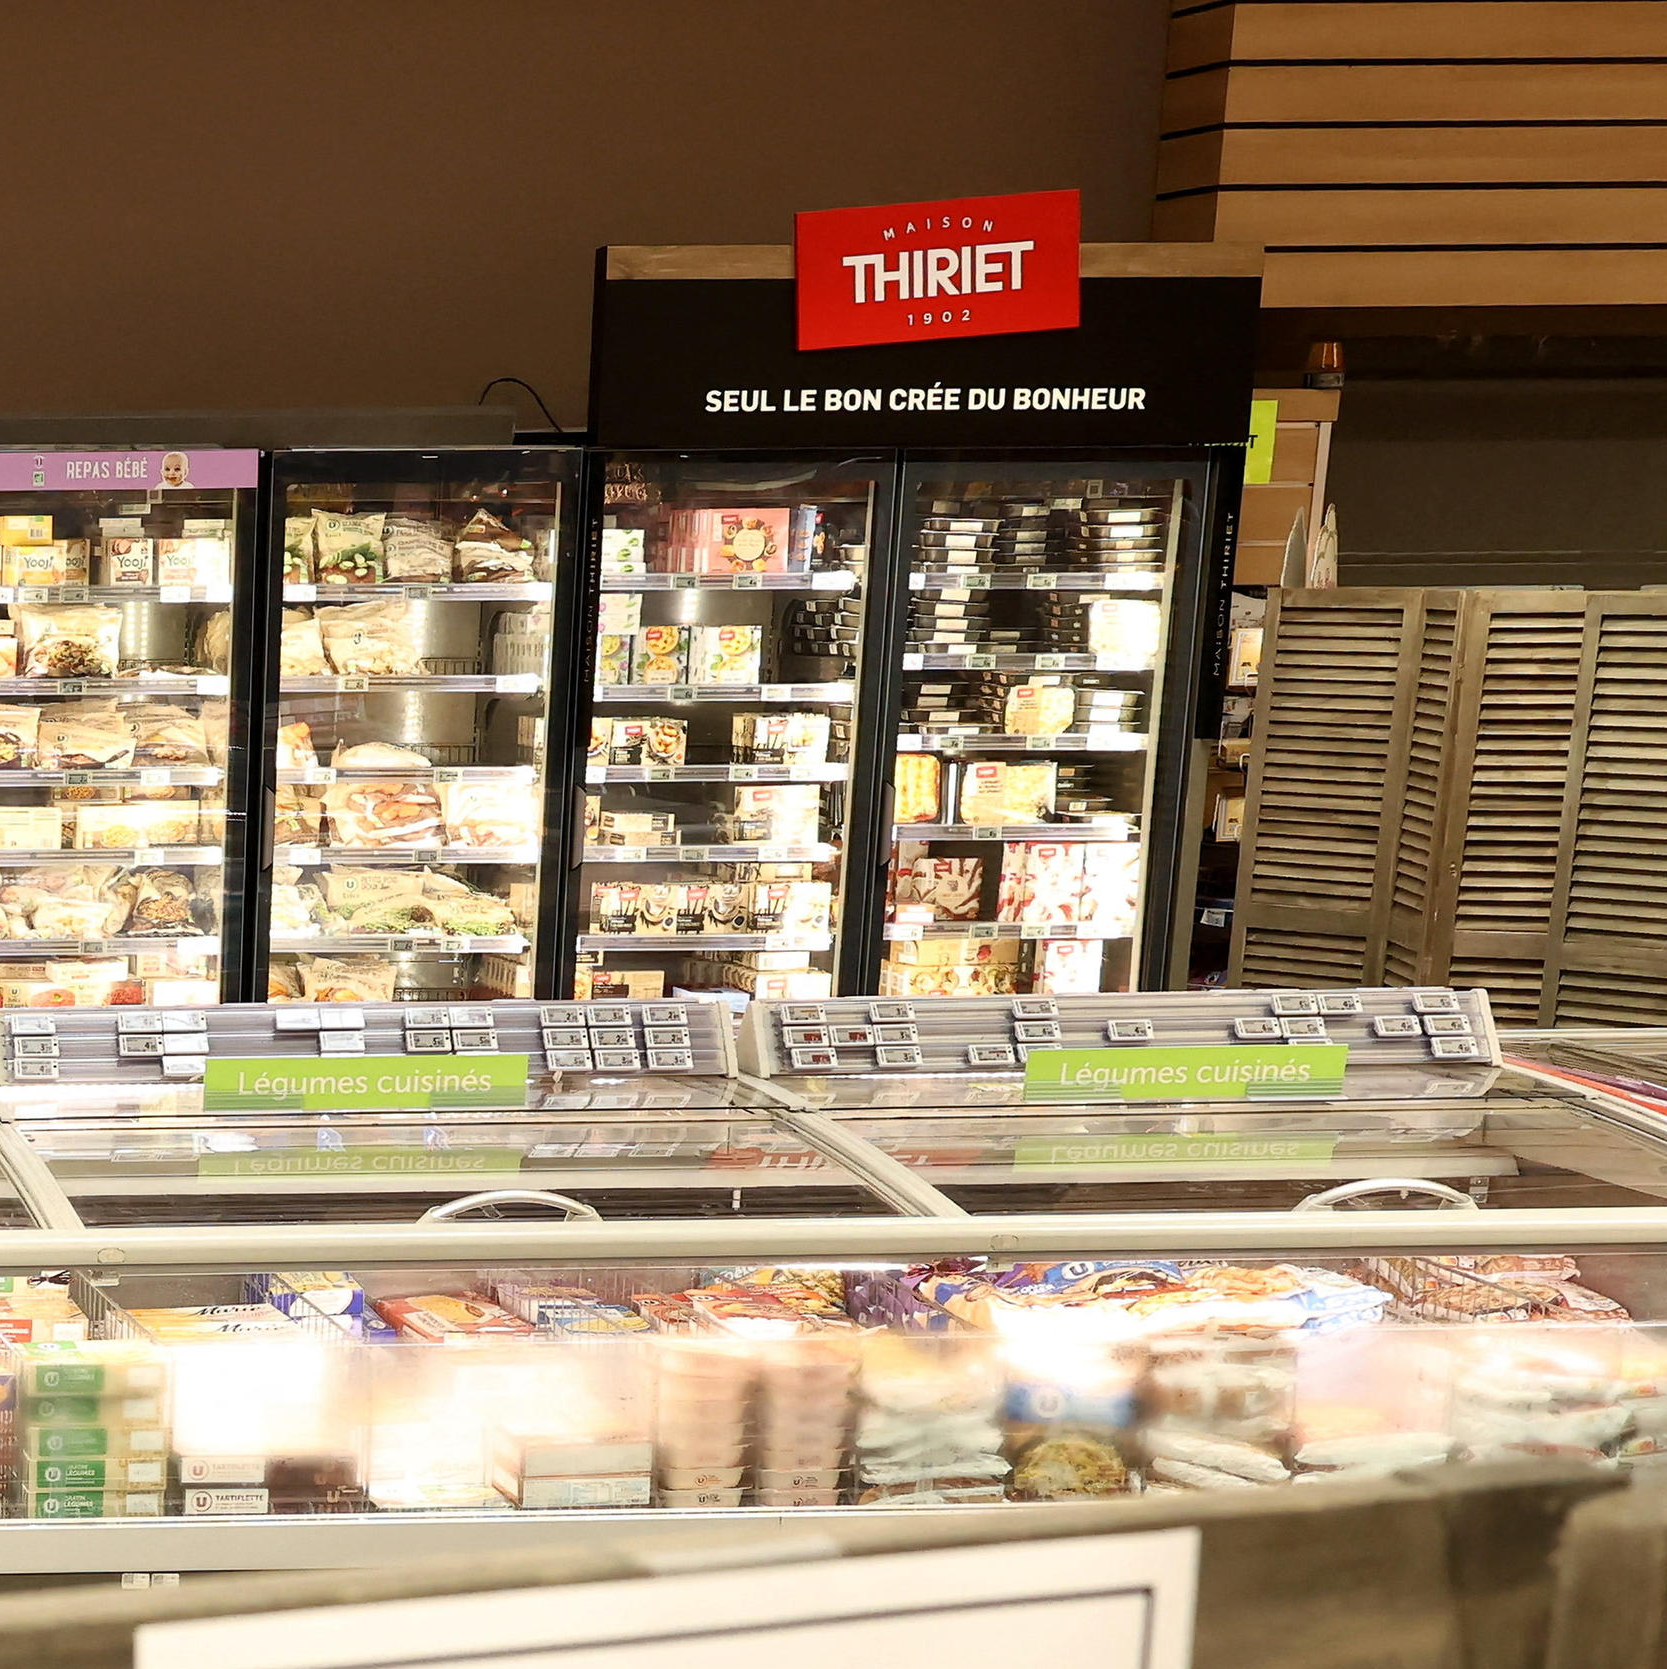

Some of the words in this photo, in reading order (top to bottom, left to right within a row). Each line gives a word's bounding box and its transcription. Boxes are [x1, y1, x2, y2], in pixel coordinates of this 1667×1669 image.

[882, 216, 995, 241] MAISON
[842, 240, 1034, 304] THIRIET
[705, 388, 777, 413] SEUL
[783, 388, 817, 412] LE
[824, 388, 882, 412] BON
[888, 381, 961, 412] CRÉE
[968, 387, 1007, 411] DU
[1014, 386, 1147, 411] BONHEUR
[66, 461, 110, 480] REPAS
[115, 457, 148, 478] BÉBÉ
[23, 555, 55, 570] Yooji
[65, 555, 85, 570] ooji
[117, 555, 148, 570] Yooji
[1212, 600, 1226, 677] MAISON
[1220, 511, 1234, 589] THIRIET
[238, 1070, 368, 1103] Légumes
[377, 1068, 492, 1094] cuisinés
[1060, 1062, 1188, 1092] Légumes
[1196, 1059, 1311, 1084] cuisinés
